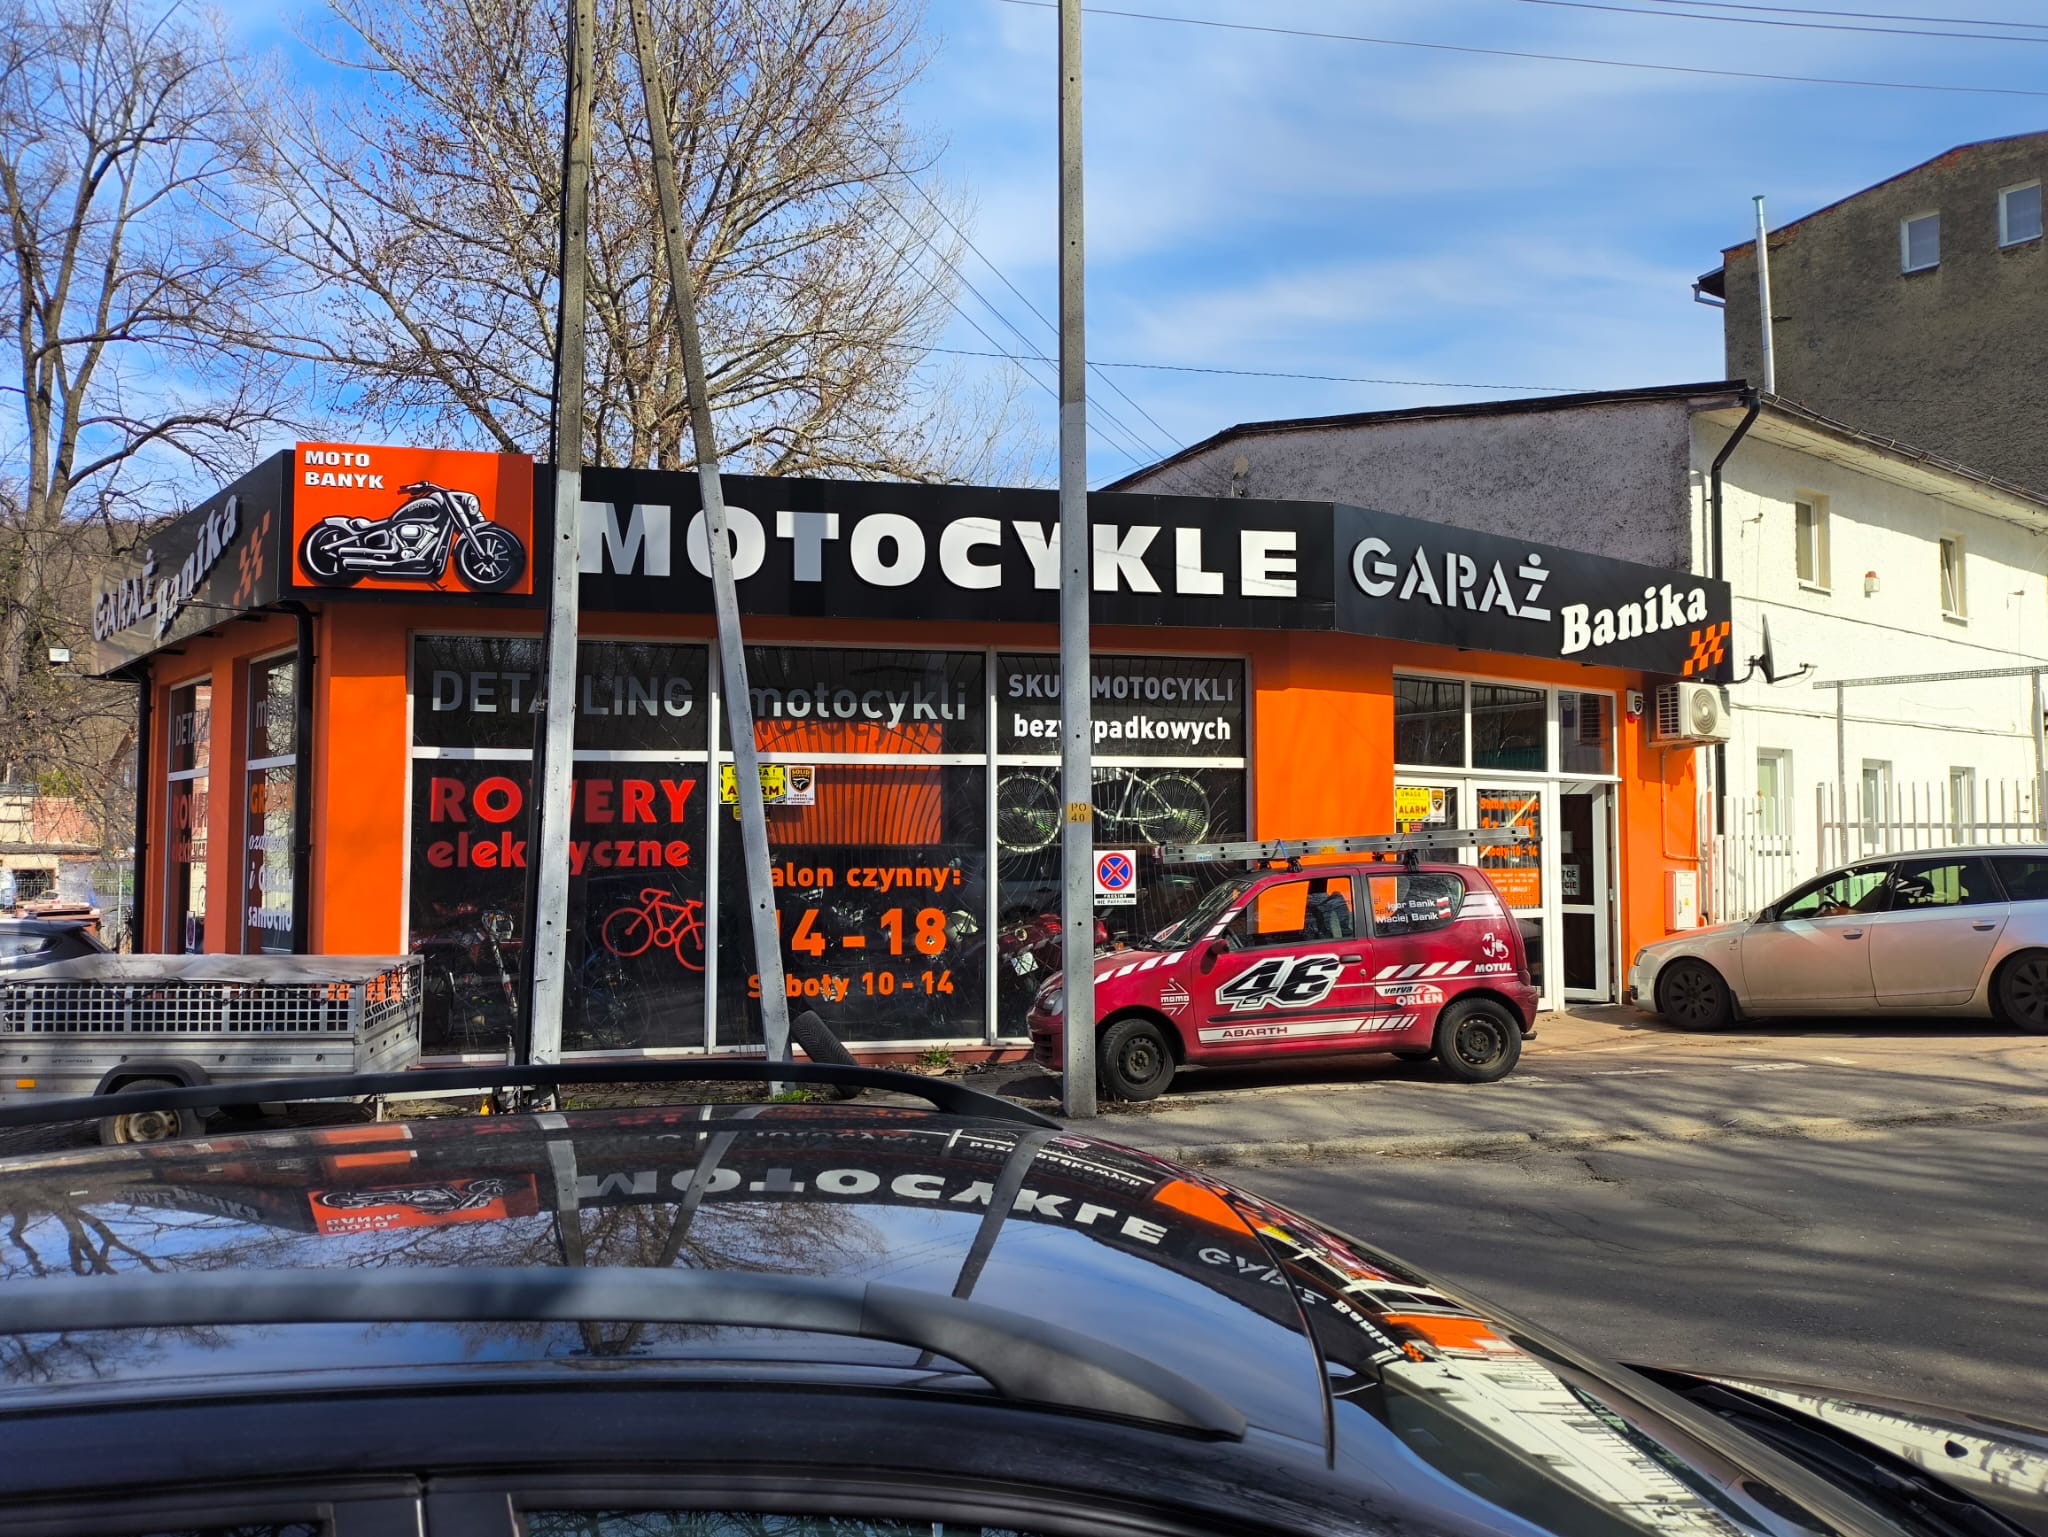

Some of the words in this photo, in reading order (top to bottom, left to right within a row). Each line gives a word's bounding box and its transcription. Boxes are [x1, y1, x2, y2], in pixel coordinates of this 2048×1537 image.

[304, 450, 370, 468] MOTO
[304, 471, 385, 489] BANYK
[579, 500, 1298, 598] MOTOCYKLE
[1352, 536, 1552, 622] GARAŻ
[1560, 583, 1709, 655] Banika
[432, 670, 694, 717] DETLING
[1008, 673, 1061, 698] SKU
[1091, 676, 1233, 701] MOTOCYKLI
[1014, 713, 1231, 744] bezpadkowych
[430, 776, 697, 824] ROERY
[728, 786, 780, 796] ARM
[1071, 802, 1087, 811] PO
[1399, 805, 1427, 815] ALARM
[1071, 814, 1085, 822] 40
[427, 832, 690, 876] elekyczne
[771, 862, 834, 887] alon
[847, 867, 961, 893] czynny:
[1408, 899, 1436, 908] Banik
[1376, 914, 1408, 924] Maciej
[1411, 912, 1439, 921] Banik
[881, 908, 946, 955] 18
[1475, 962, 1512, 973] MOTUL
[748, 974, 848, 1002] Sboty
[862, 972, 894, 995] 10
[922, 971, 953, 994] 14
[1216, 953, 1345, 1012] 46
[1384, 986, 1412, 995] verva
[1160, 995, 1189, 1003] momo
[1396, 993, 1443, 1006] ORLEN
[1222, 1026, 1288, 1038] ABARTH
